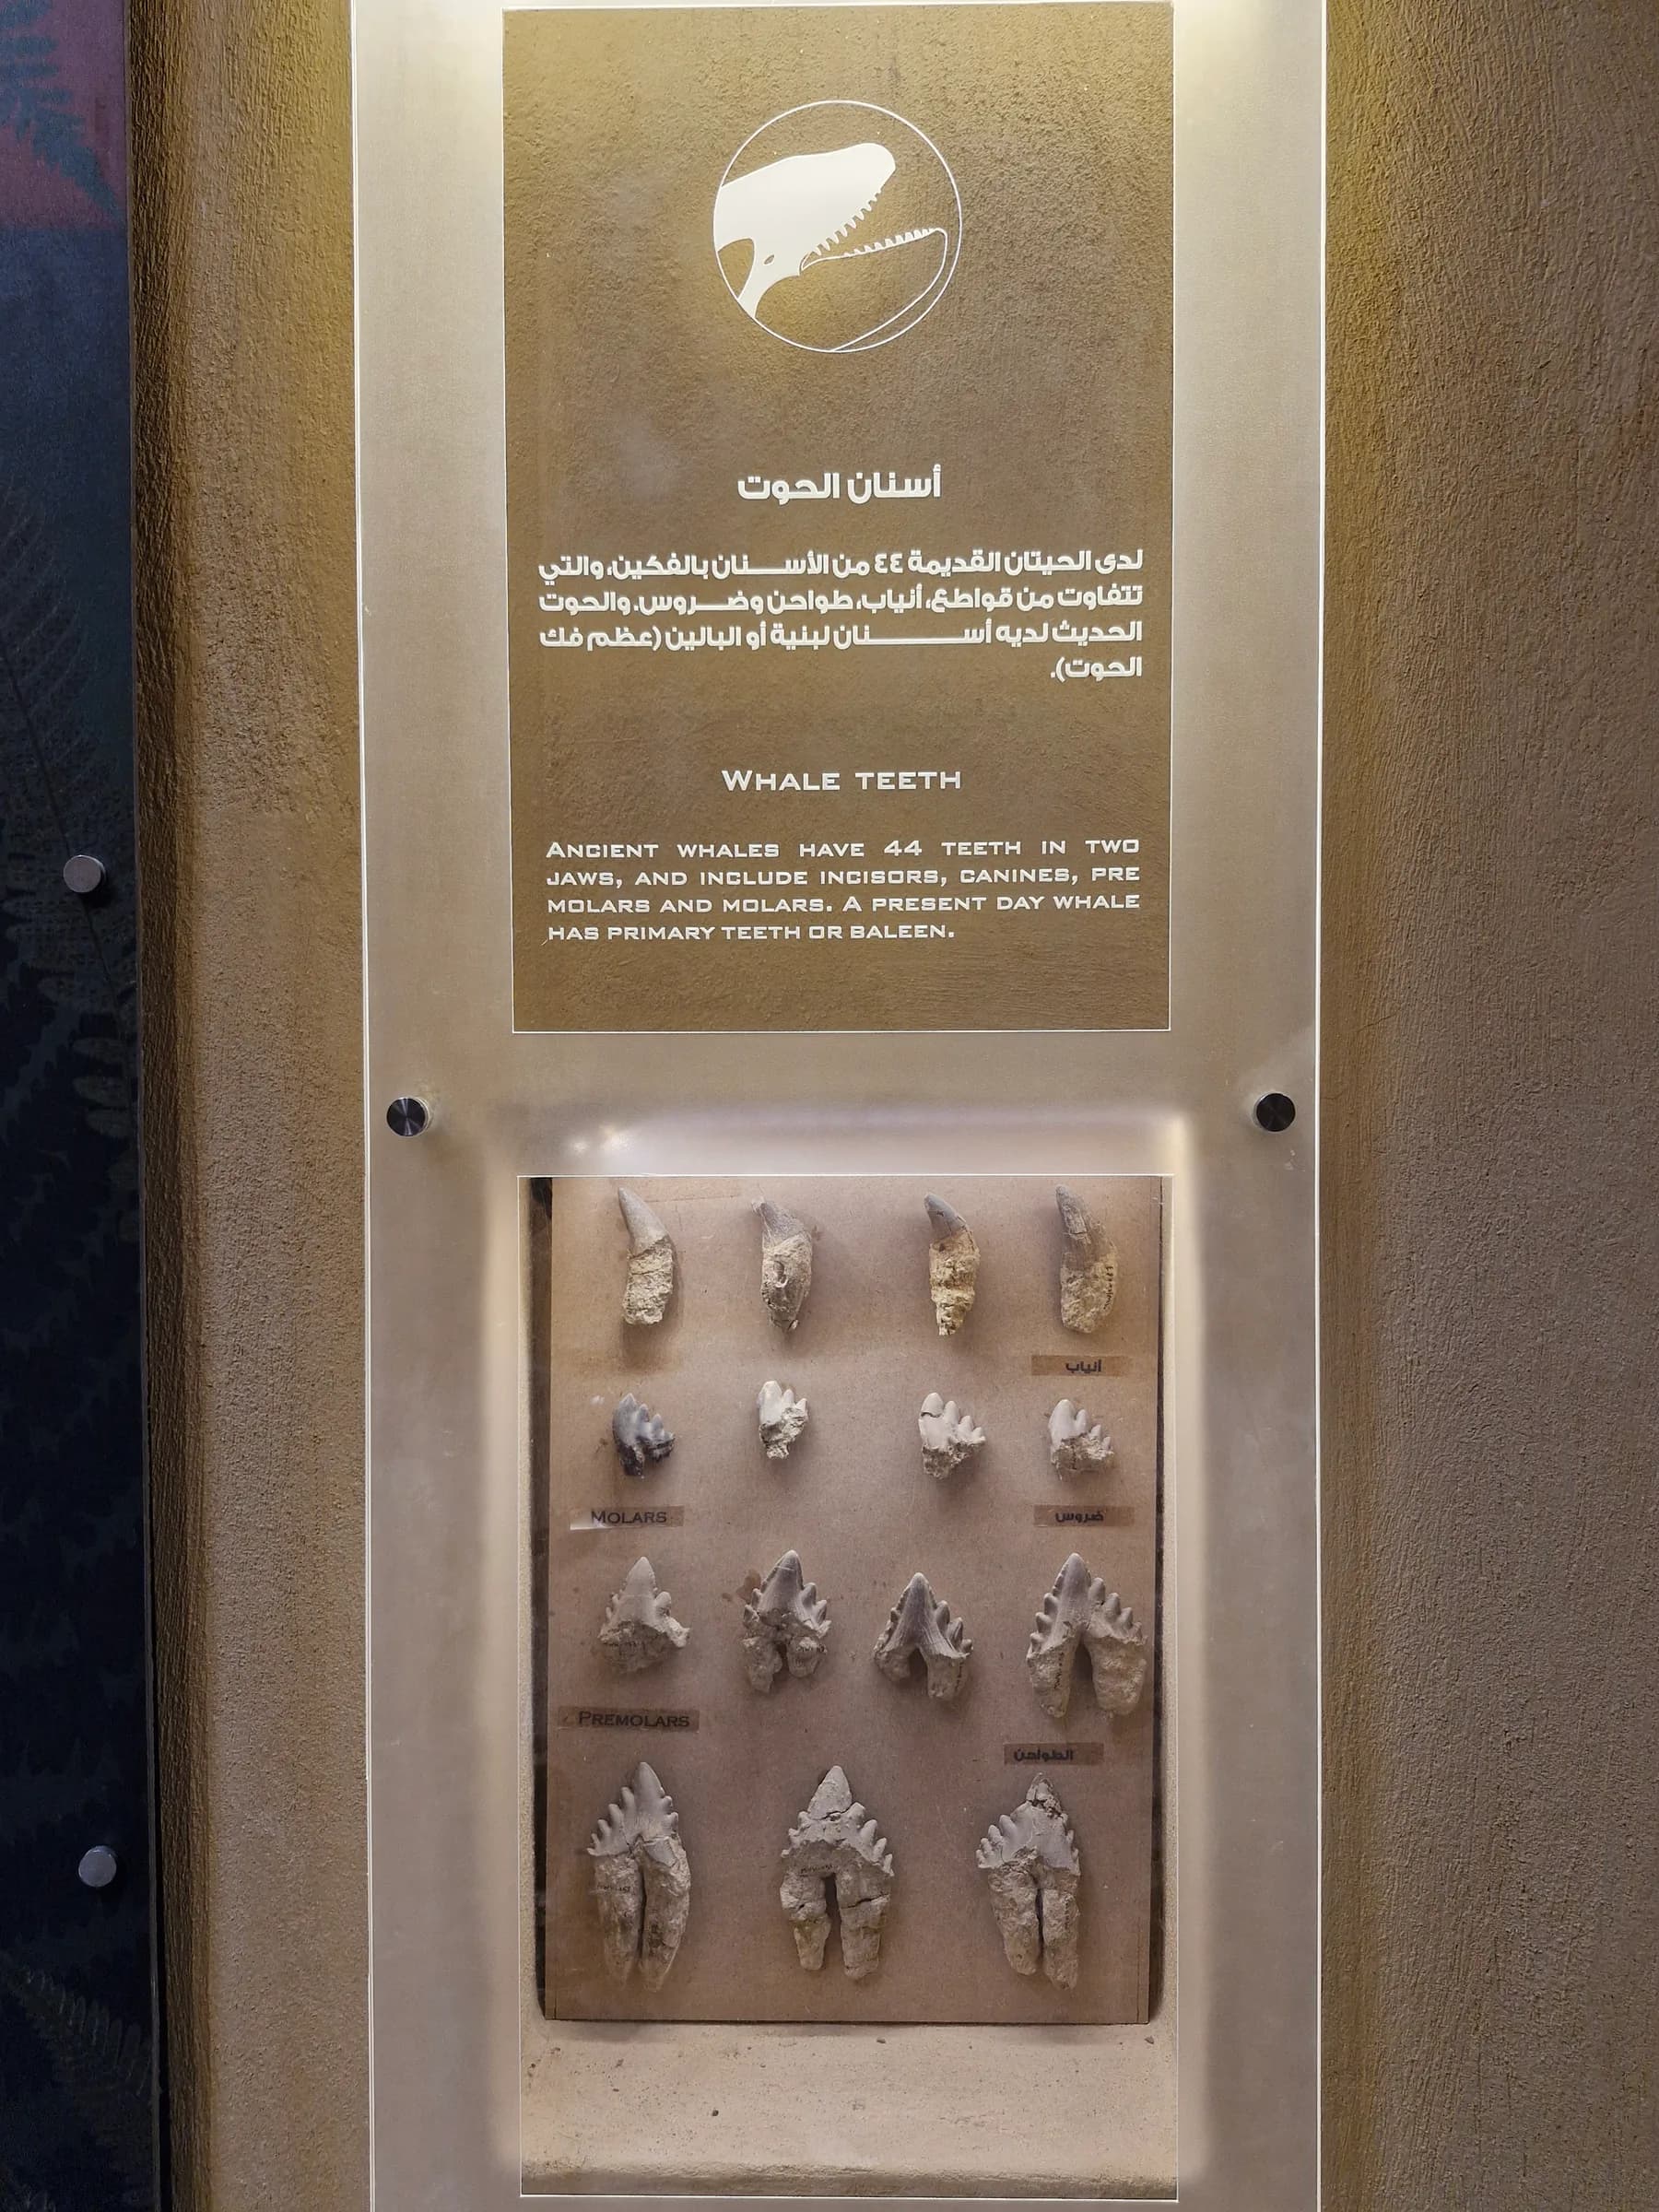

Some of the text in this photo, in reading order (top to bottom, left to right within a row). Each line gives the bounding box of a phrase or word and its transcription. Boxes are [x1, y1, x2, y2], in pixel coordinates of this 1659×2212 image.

[738, 464, 941, 505] أسنان الحوت
[538, 556, 604, 585] والتي
[607, 552, 708, 580] بالفكين،
[832, 554, 870, 578] من
[875, 553, 903, 573] ٤٤
[908, 549, 1001, 577] القديمة
[1005, 550, 1091, 575] الحيتان
[1095, 548, 1143, 574] لدى
[539, 592, 630, 616] والحوت
[767, 590, 853, 614] طواحن
[856, 582, 922, 614] أنياب،
[926, 587, 1013, 612] قواطع،
[1017, 587, 1053, 611] من
[1058, 583, 1143, 610] تتفاوت
[540, 627, 583, 646] فك
[587, 626, 661, 651] (عظم
[665, 626, 741, 651] البالين
[747, 621, 766, 650] أو
[771, 623, 830, 650] لبنية
[995, 623, 1048, 647] لديه
[1053, 620, 1142, 646] الحديث
[1051, 656, 1142, 682] الحوت).
[677, 844, 779, 857] WHALES
[800, 843, 865, 857] HAVE
[884, 841, 922, 856] 44
[941, 841, 1020, 855] TEETH
[1042, 841, 1065, 854] IN
[1085, 840, 1139, 853] TWO
[547, 867, 1139, 888] JAWS, AND INCLUDE INCISORS, CANINES, PRE
[548, 895, 1139, 912] MOLARS AND MOLARS. A PRESENT DAY WHALE
[548, 925, 954, 940] HAS PRIMARY TEETH OR BALEEN.
[1066, 1359, 1102, 1373] أنياب
[1055, 1511, 1104, 1523] ضروس
